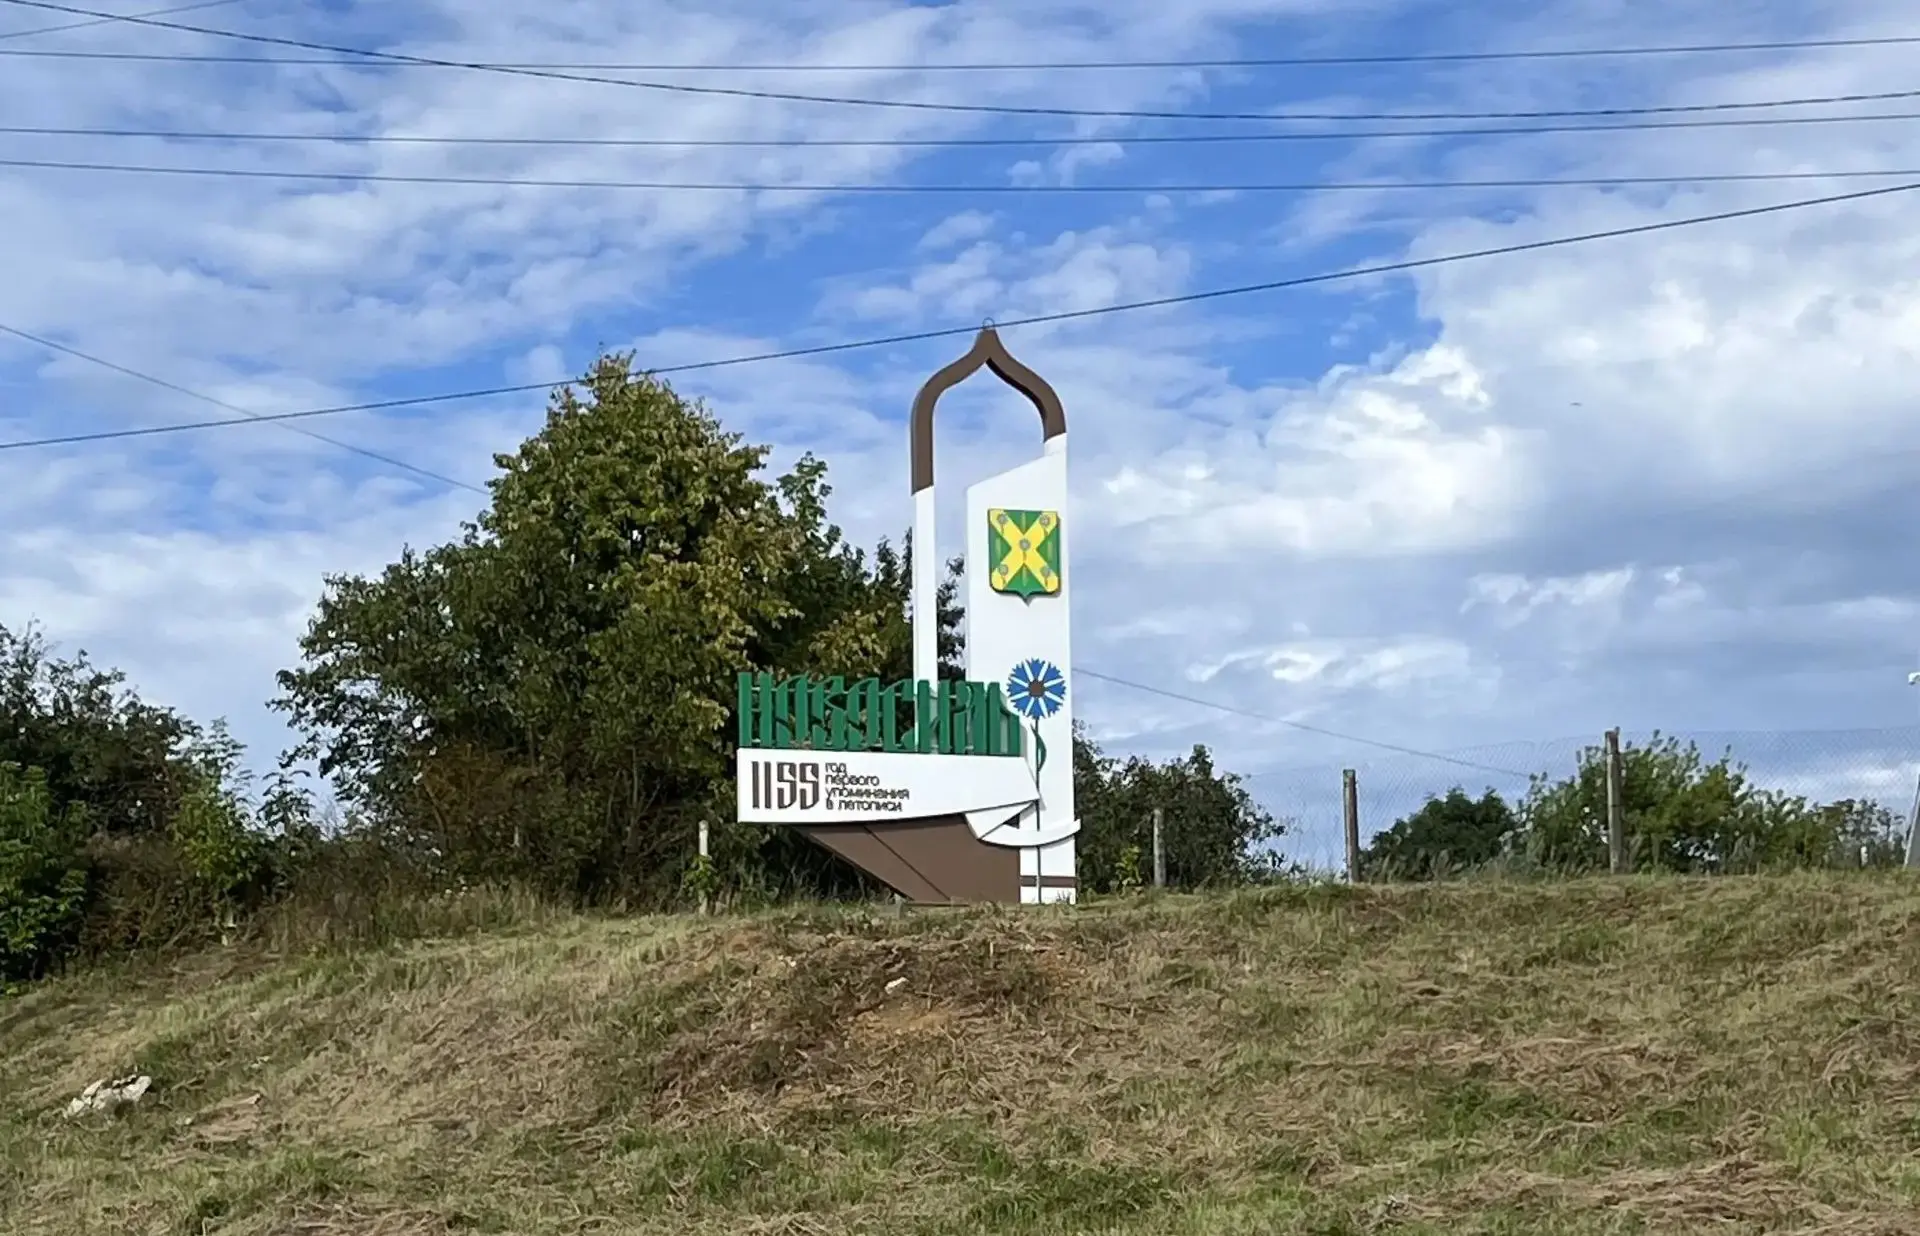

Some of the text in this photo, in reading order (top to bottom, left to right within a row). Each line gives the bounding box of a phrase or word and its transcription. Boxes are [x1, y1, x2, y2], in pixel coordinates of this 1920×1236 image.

[825, 763, 847, 775] год
[752, 761, 819, 810] 1155
[825, 775, 880, 788] первого
[825, 788, 909, 801] упоминания
[838, 800, 902, 812] летописи
